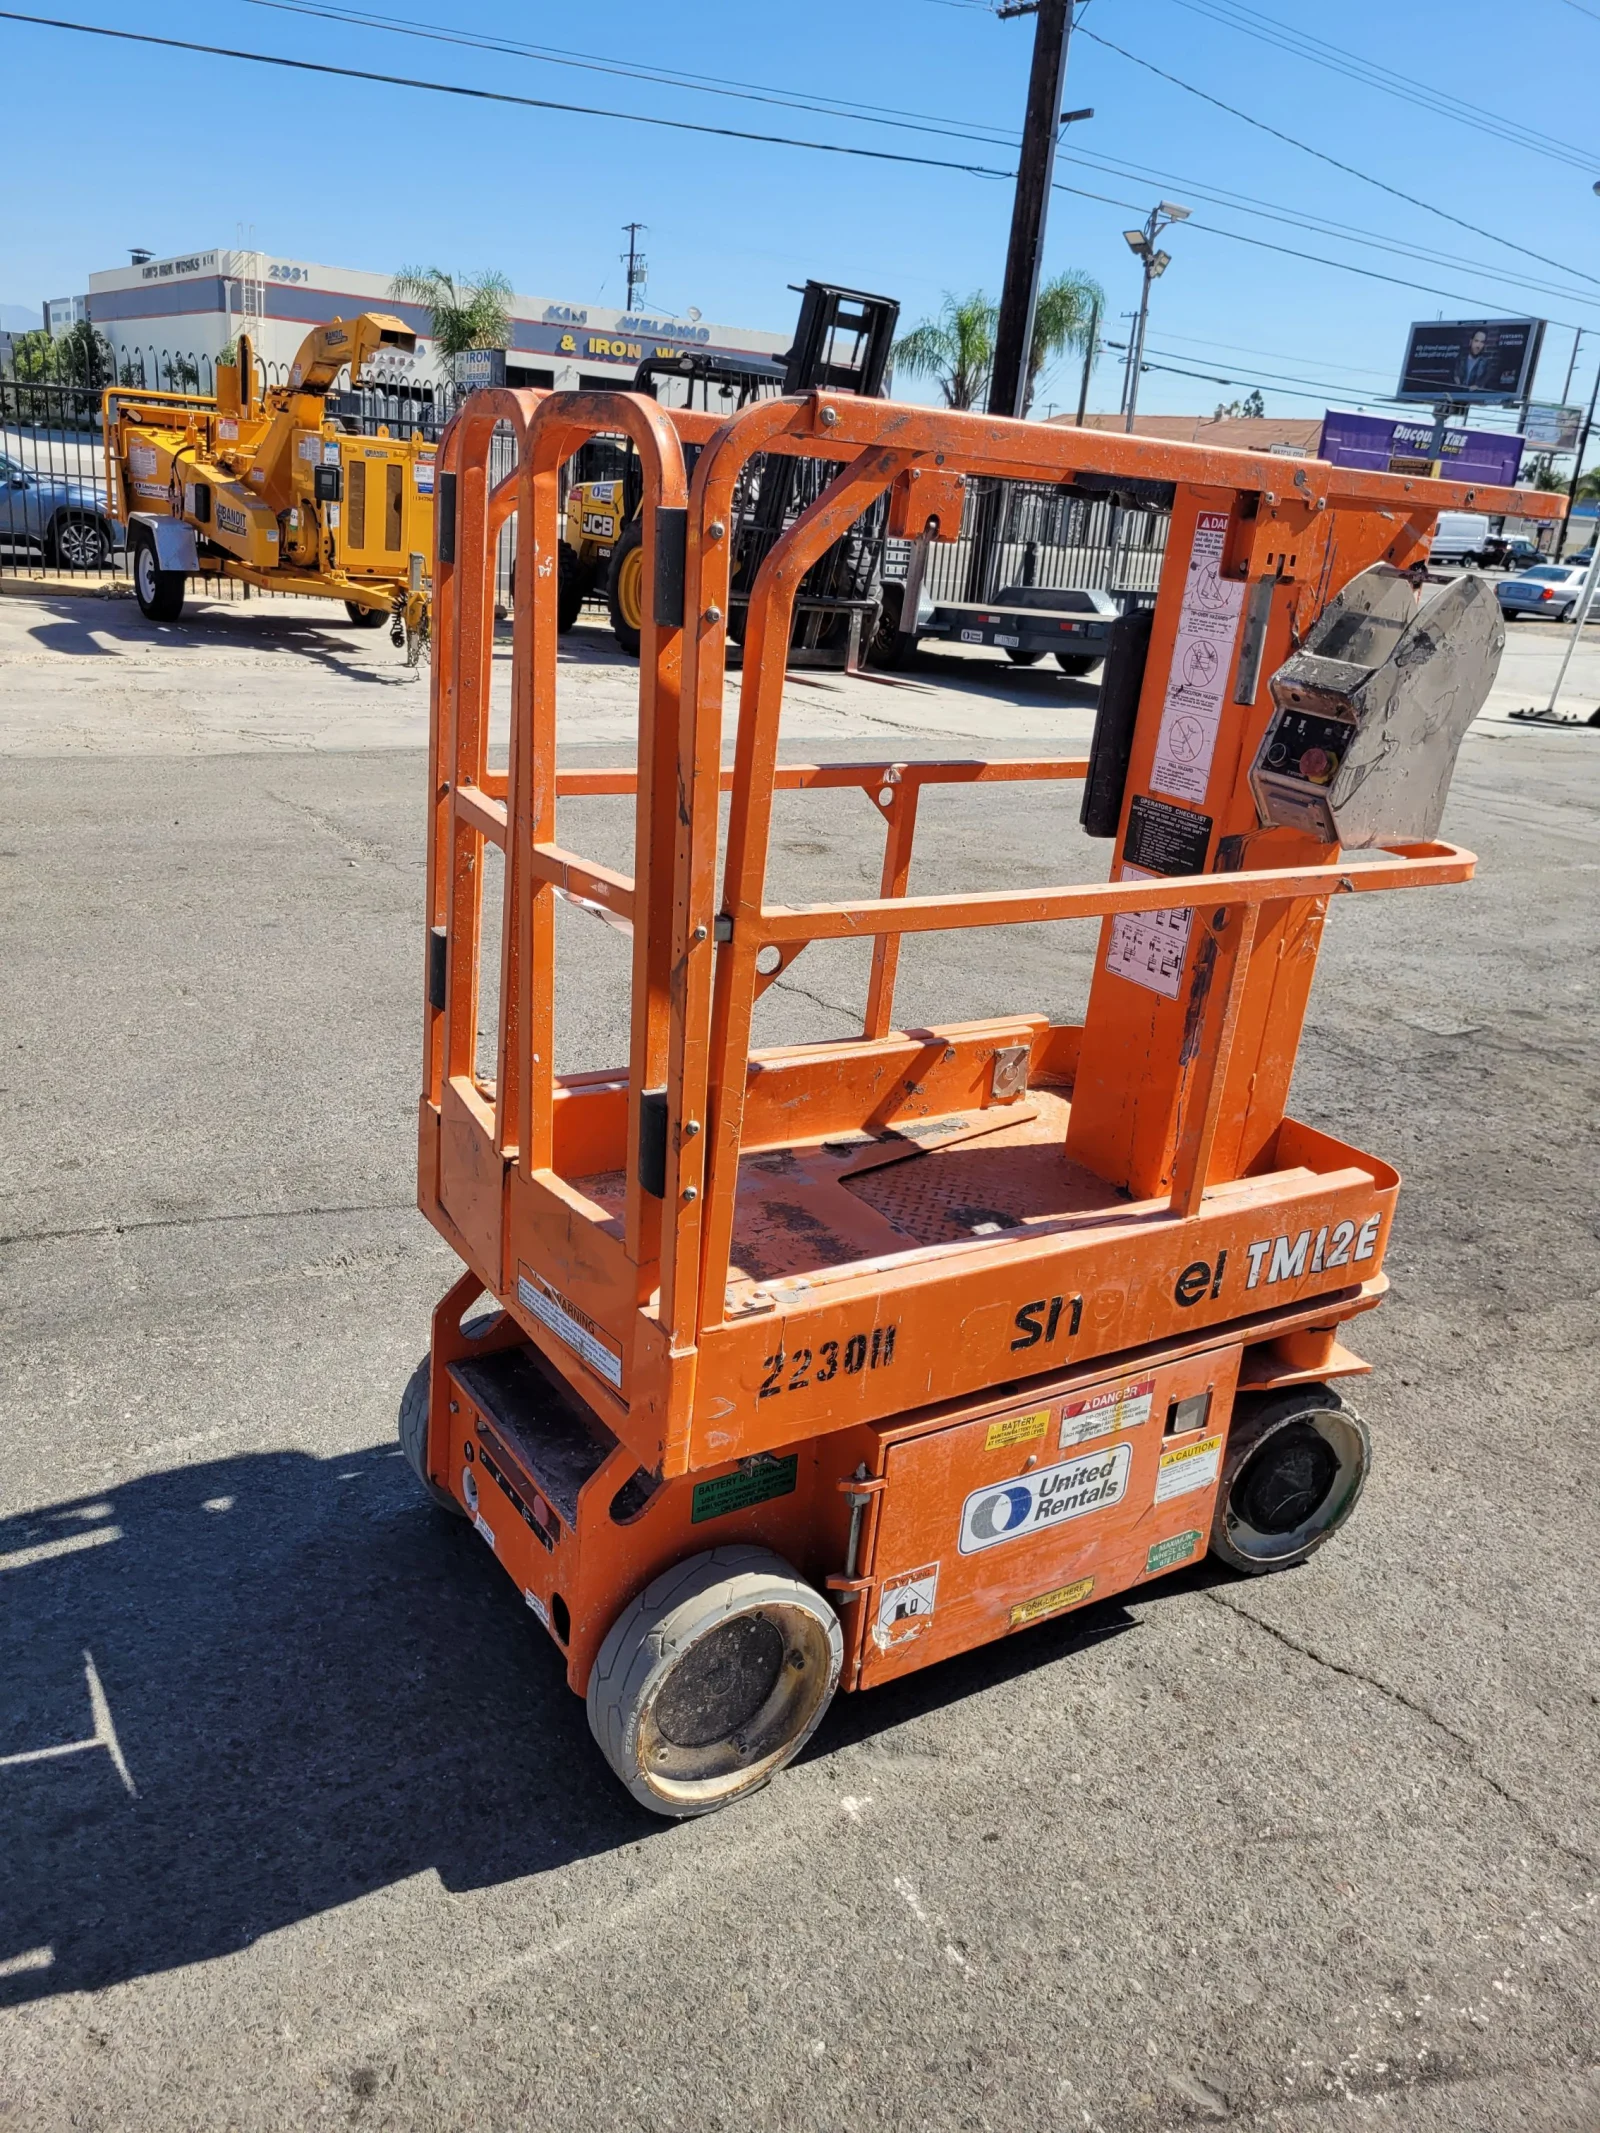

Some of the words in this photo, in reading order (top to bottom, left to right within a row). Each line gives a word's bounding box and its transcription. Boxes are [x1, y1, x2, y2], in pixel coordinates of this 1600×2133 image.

[545, 305, 588, 323] KIM
[620, 316, 711, 344] WELDING
[466, 351, 490, 364] IRON
[560, 334, 577, 352] &
[588, 337, 643, 360] IRON
[583, 514, 613, 536] JCB
[1140, 798, 1172, 812] OPERATORS
[1175, 808, 1207, 823] CHECKLIST
[1245, 1211, 1383, 1290] TM12E
[1092, 1386, 1138, 1408] DANGER
[1002, 1416, 1036, 1431] BATTERY
[1176, 1441, 1215, 1461] CAUTION
[698, 1476, 737, 1495] BATTERY
[1039, 1455, 1117, 1498] United
[1033, 1478, 1119, 1522] Rentals
[1063, 1583, 1085, 1597] HERE
